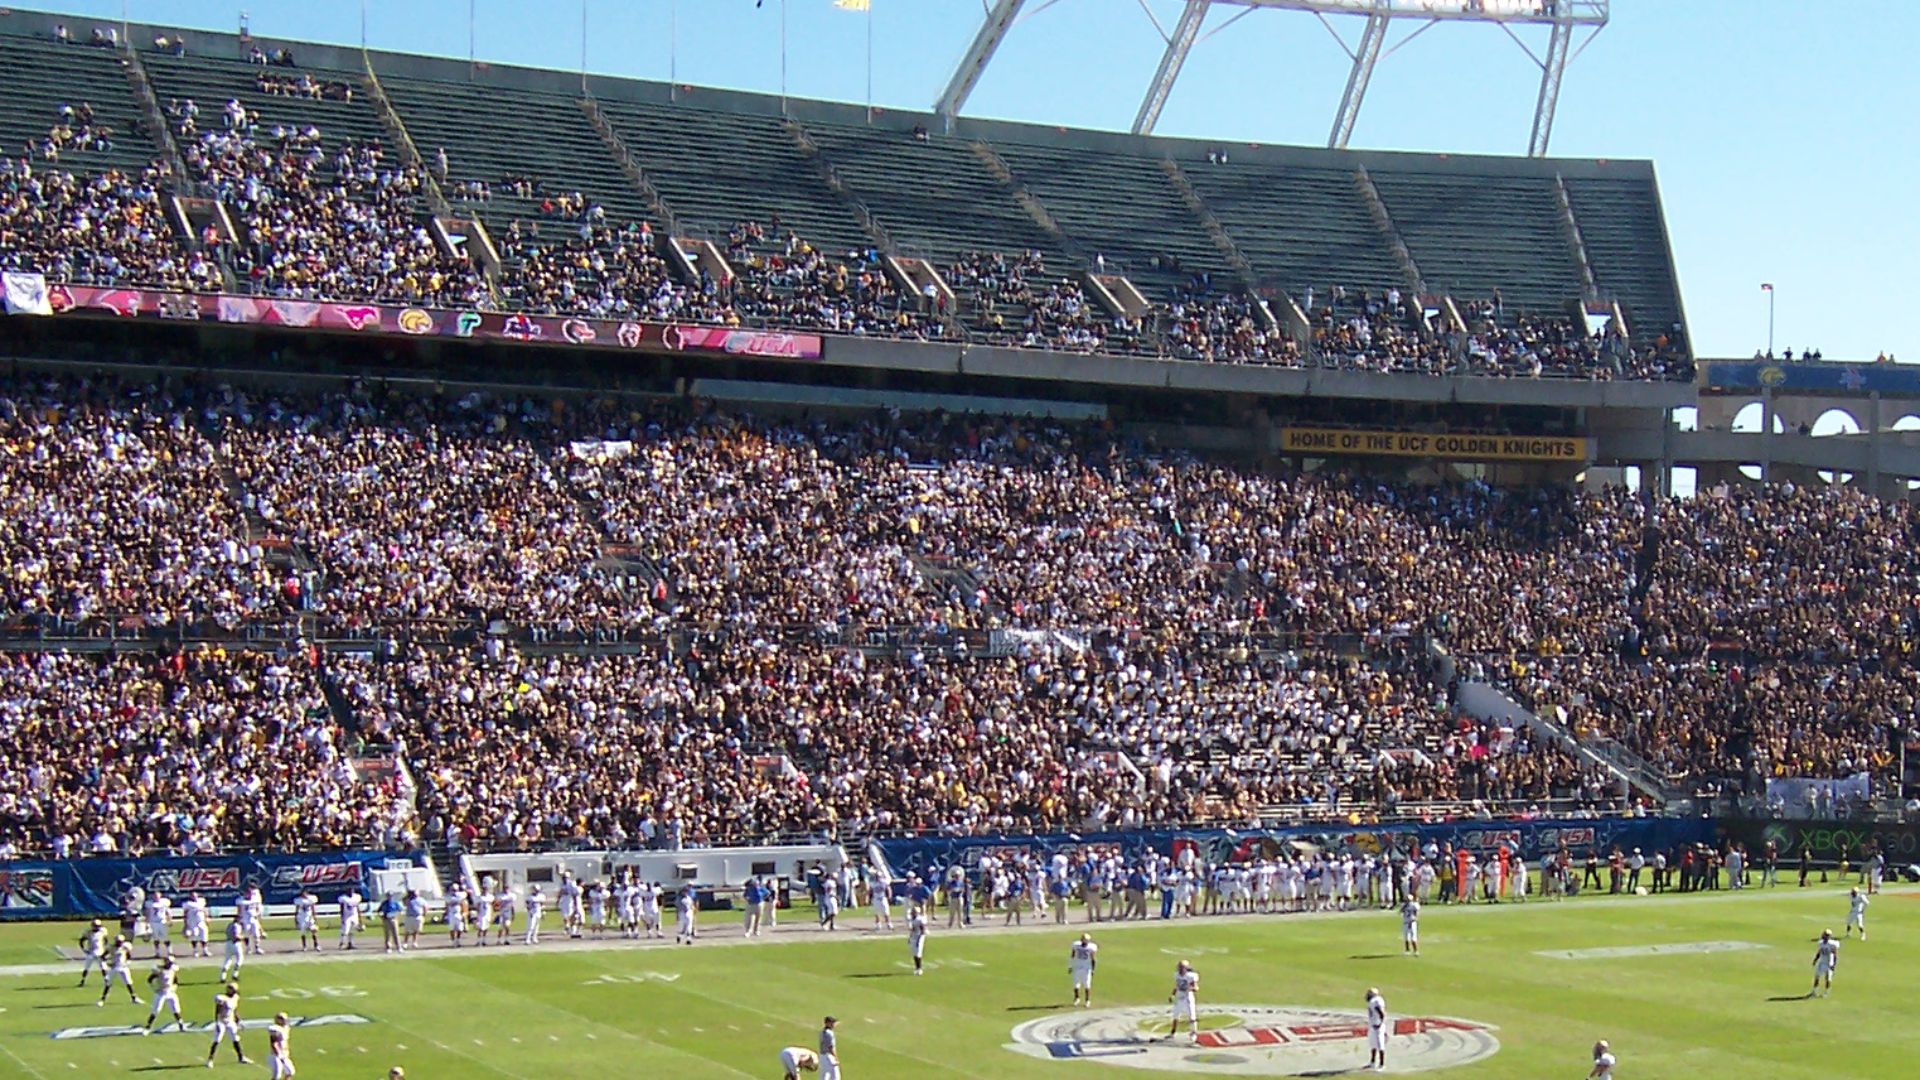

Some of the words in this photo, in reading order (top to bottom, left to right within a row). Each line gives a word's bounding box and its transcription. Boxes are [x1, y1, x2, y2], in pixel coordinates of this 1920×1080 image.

[1290, 432, 1336, 448] HOME
[1341, 433, 1360, 448] OF
[1366, 435, 1393, 450] THE
[1399, 436, 1429, 451] UCF
[1435, 437, 1497, 454] GOLDEN
[1503, 439, 1575, 456] KNIGHTS
[1798, 829, 1865, 851] XBOX
